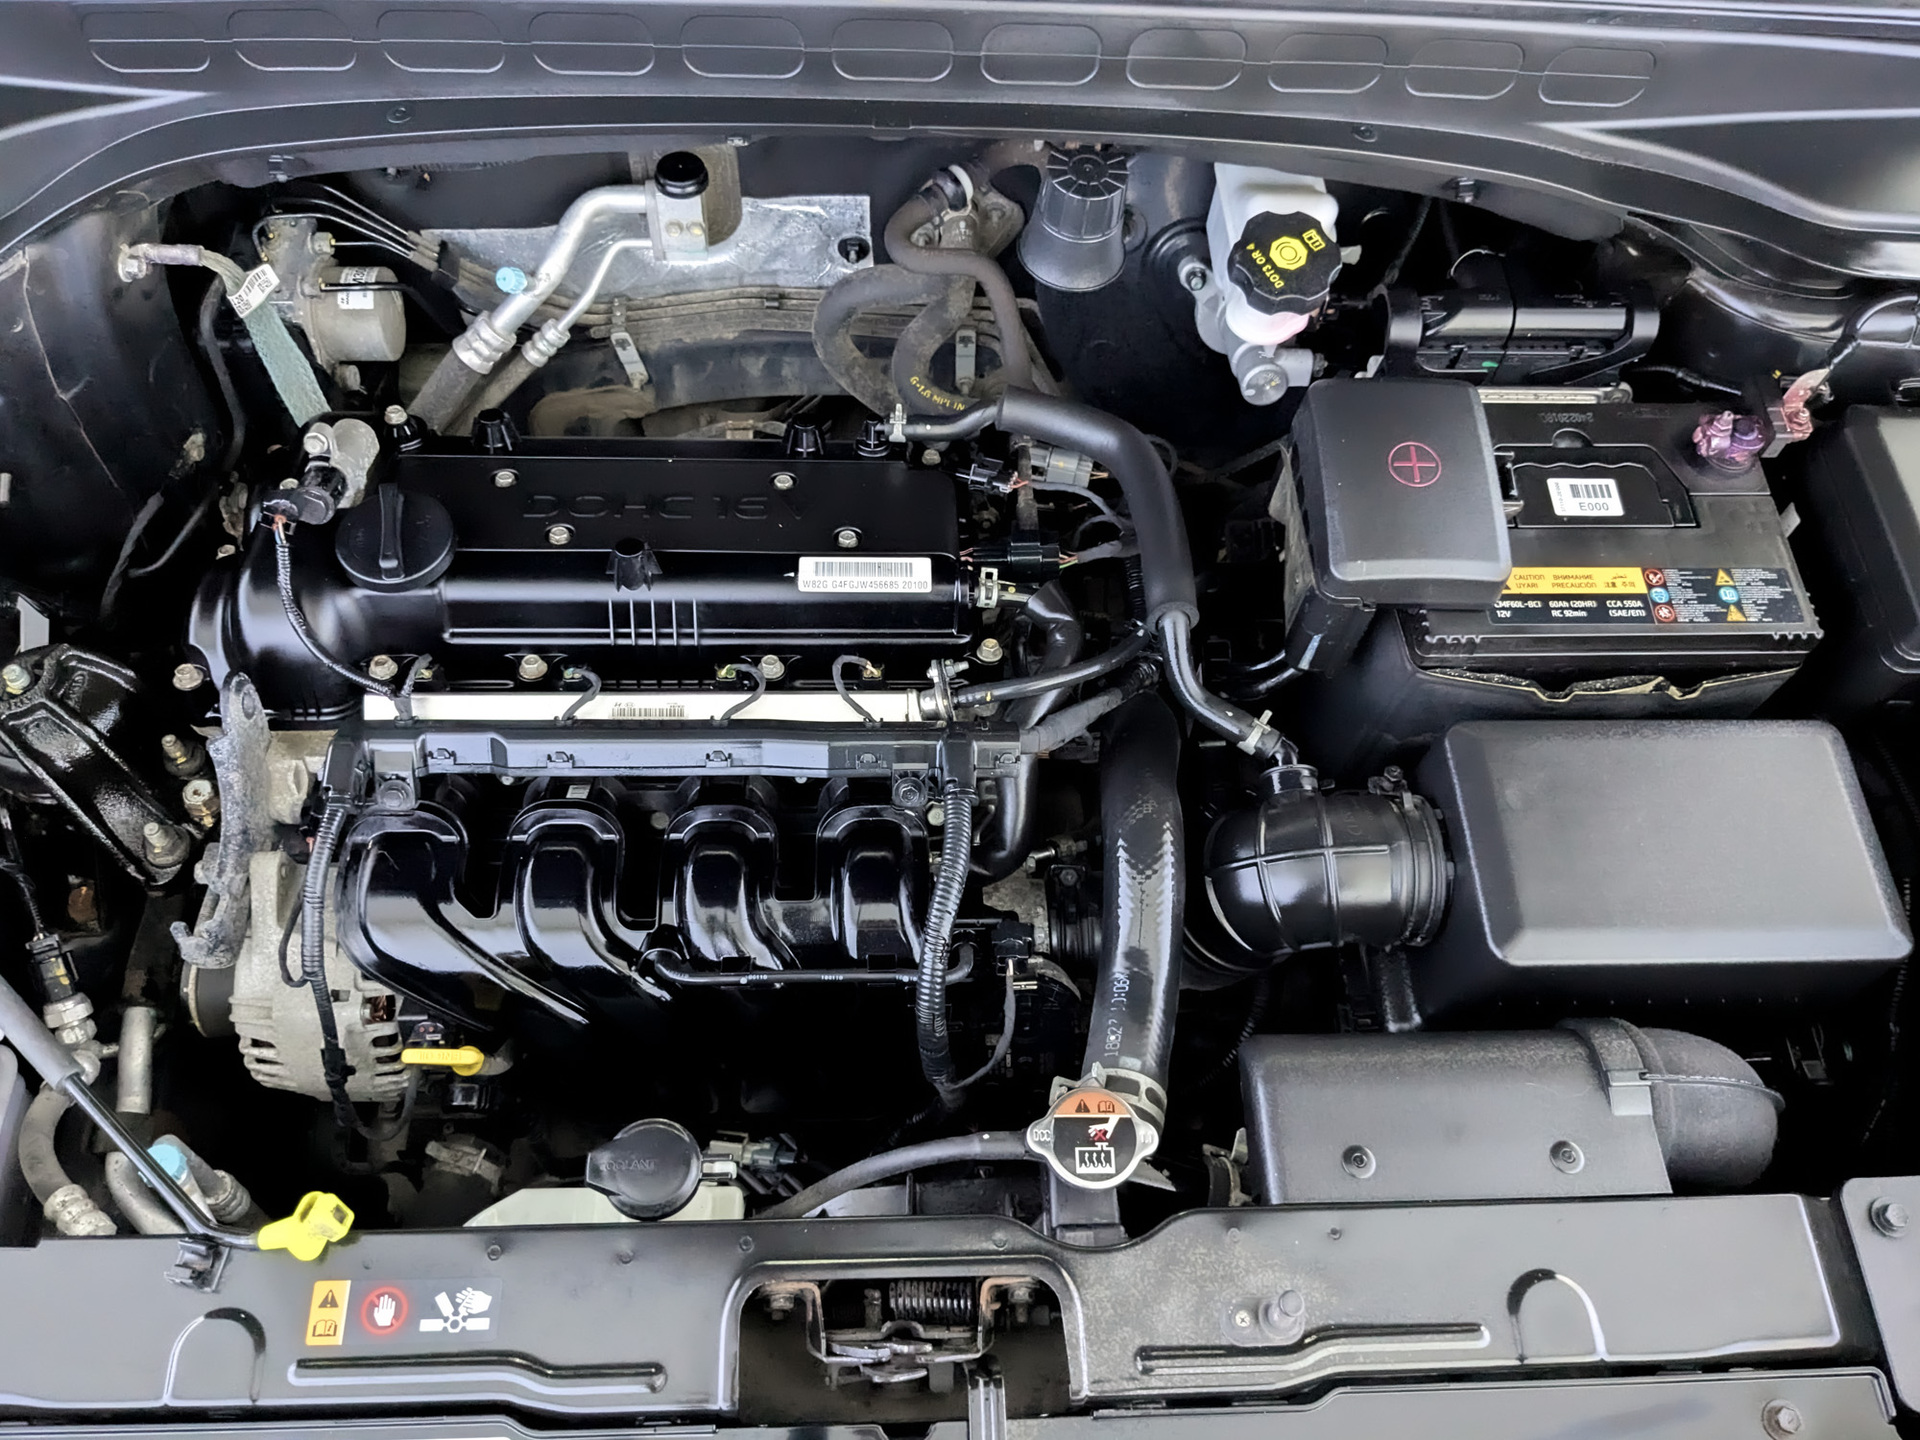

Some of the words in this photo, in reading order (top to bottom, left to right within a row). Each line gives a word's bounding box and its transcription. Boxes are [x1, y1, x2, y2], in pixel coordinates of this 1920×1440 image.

[1251, 250, 1266, 265] OR
[1262, 264, 1285, 289] DOT3
[932, 394, 950, 407] MPI
[953, 402, 966, 411] IN
[522, 494, 695, 520] DOHC
[712, 493, 818, 521] 16V
[1579, 501, 1610, 512] E000
[802, 580, 829, 590] W82G
[901, 580, 929, 590] 20100
[1605, 600, 1623, 608] CCA
[1622, 600, 1644, 608] 550A
[1496, 610, 1512, 618] 12V
[1551, 609, 1564, 618] RC
[1563, 609, 1589, 618] 92min
[600, 1158, 658, 1172] COOLANT
